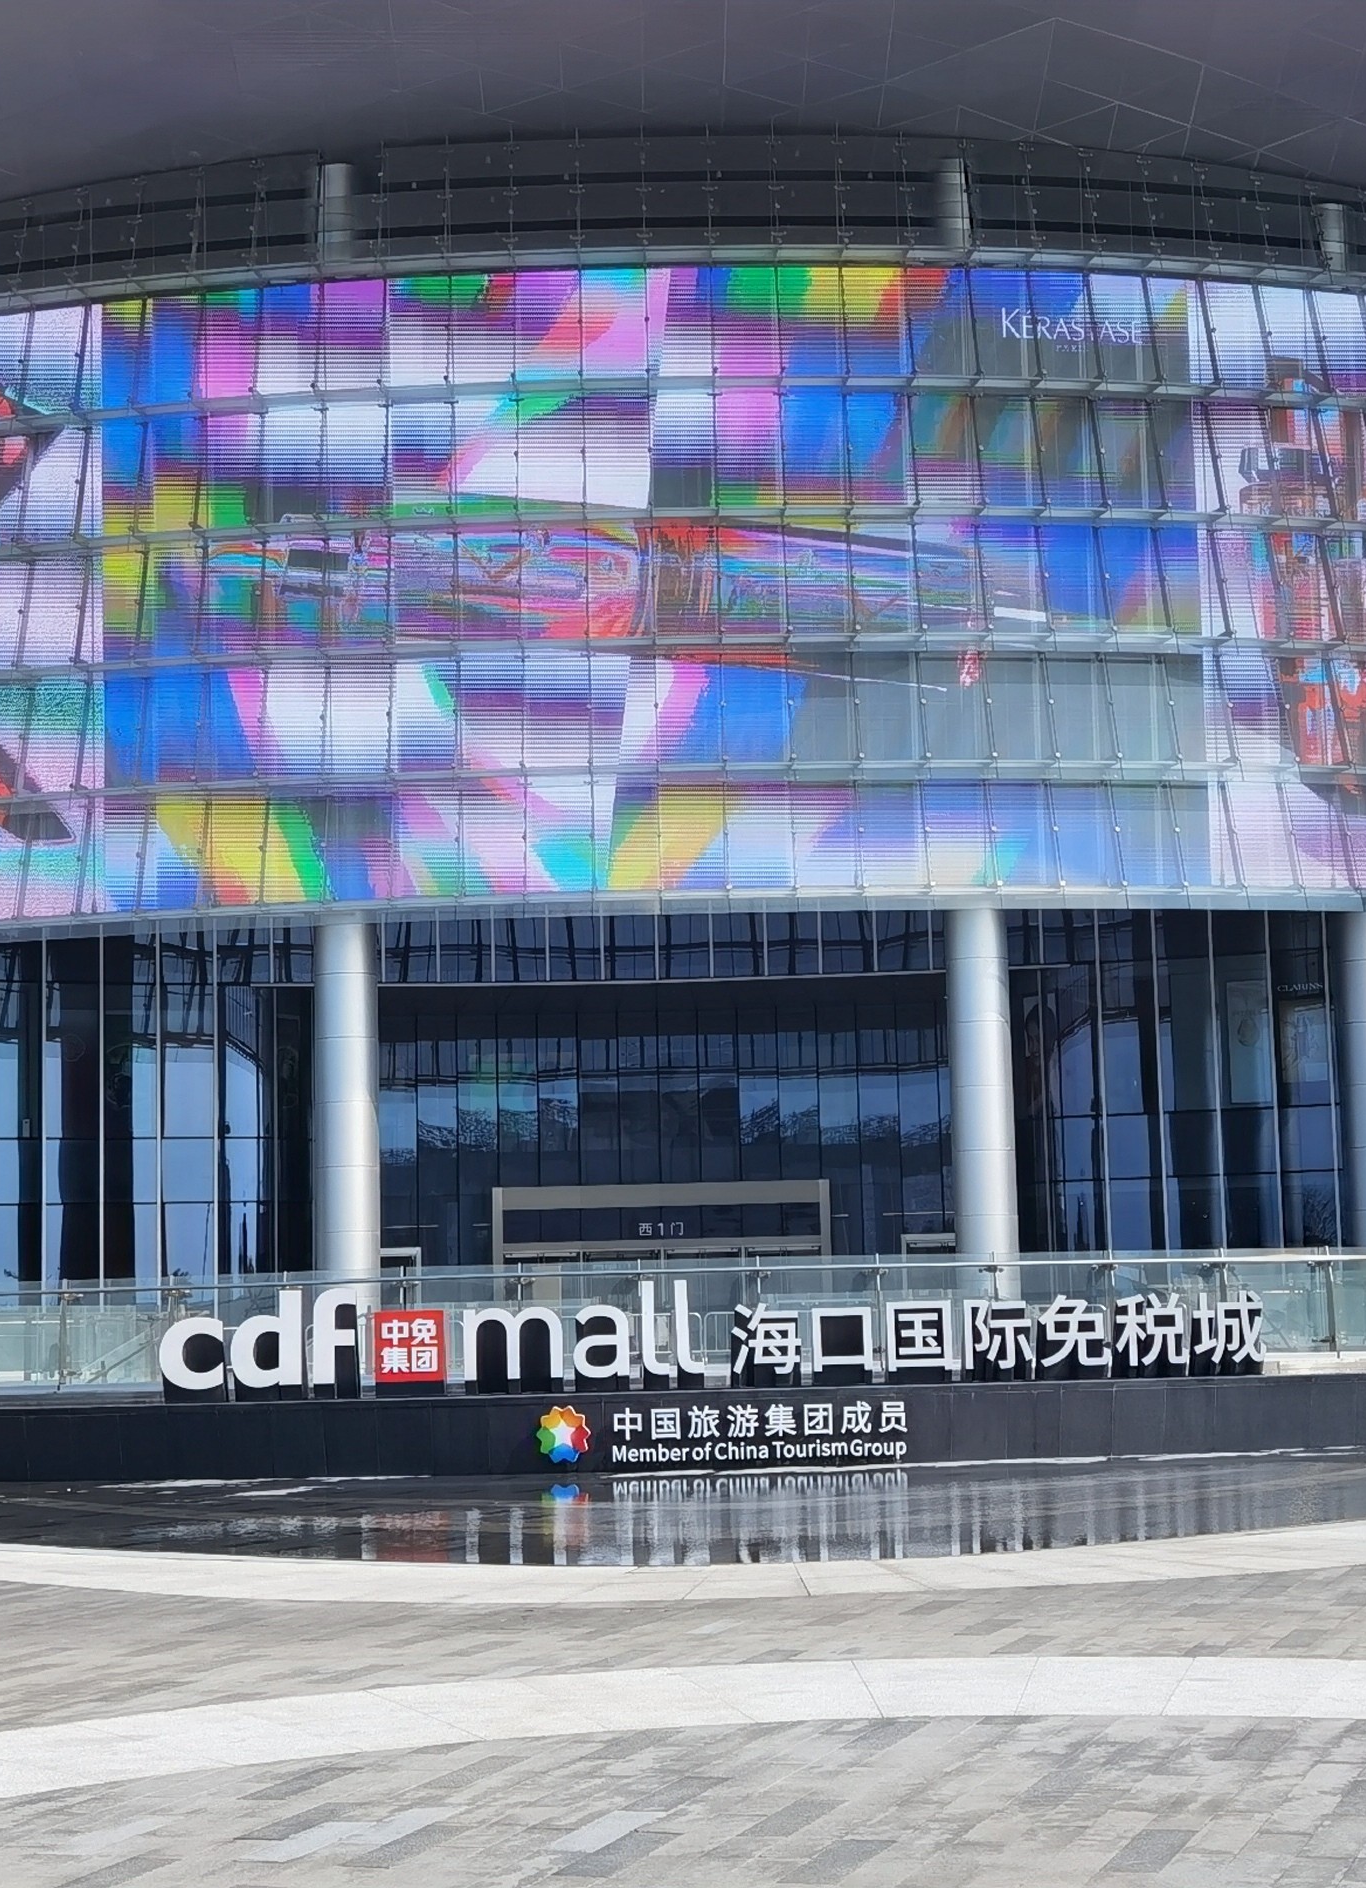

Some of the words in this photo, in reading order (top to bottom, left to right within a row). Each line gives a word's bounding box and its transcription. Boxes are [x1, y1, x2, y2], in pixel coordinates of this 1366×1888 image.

[638, 1222, 684, 1236] 西1门
[159, 1288, 358, 1390] cdf
[463, 1279, 705, 1380] mall
[731, 1290, 1267, 1375] 海口国际免税城
[381, 1319, 438, 1345] 中免
[380, 1346, 439, 1373] 集团
[612, 1401, 908, 1441] 中国旅游集团成员
[611, 1443, 689, 1463] Member
[691, 1441, 712, 1461] of
[714, 1440, 769, 1461] China
[772, 1440, 849, 1459] Tourism
[850, 1439, 908, 1461] Group
